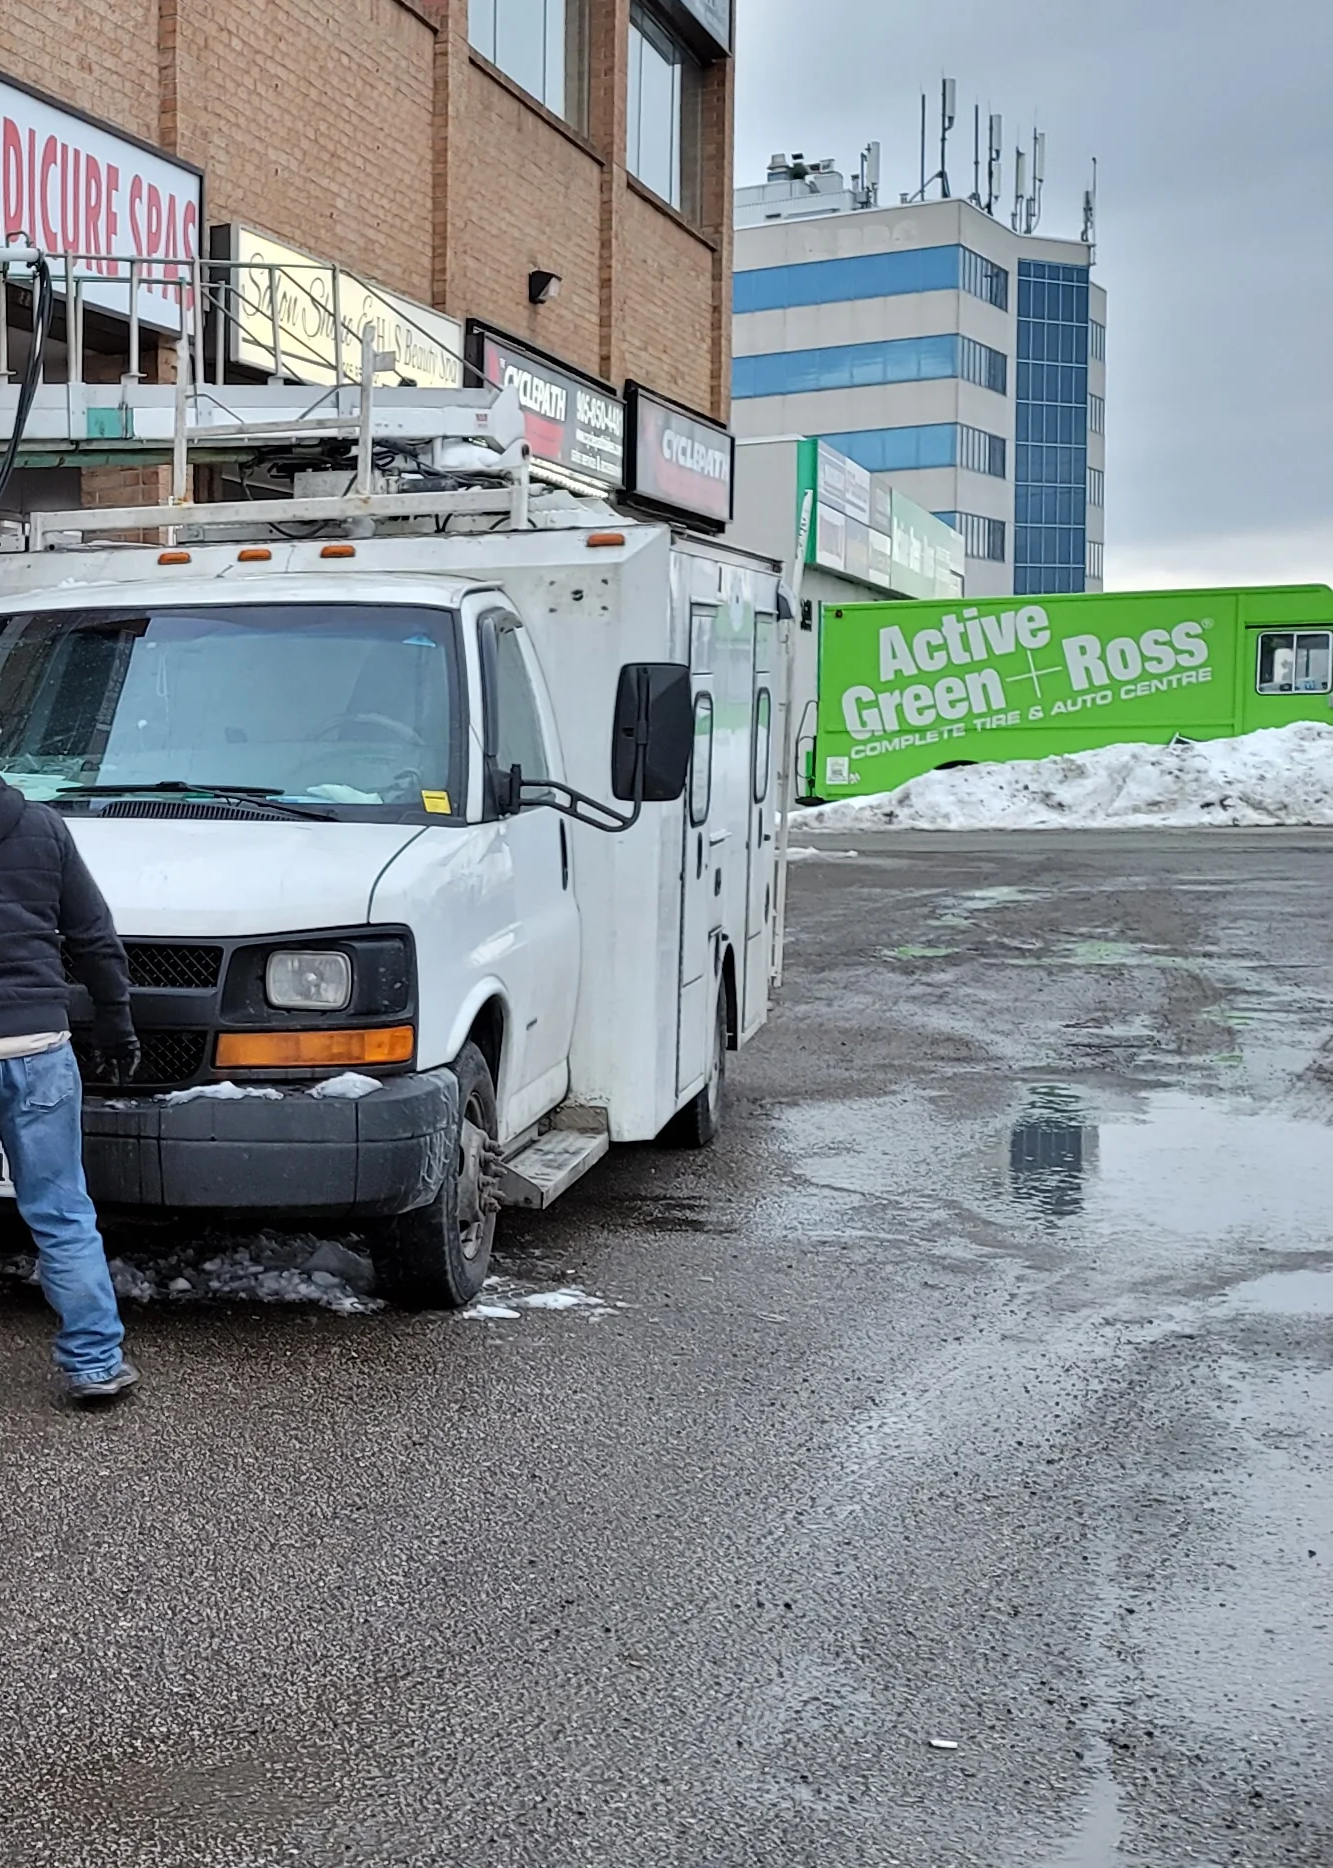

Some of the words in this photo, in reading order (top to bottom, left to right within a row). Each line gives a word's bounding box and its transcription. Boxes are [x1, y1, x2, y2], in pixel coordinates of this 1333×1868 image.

[129, 174, 196, 311] SPAS
[879, 605, 1051, 682] Active
[841, 667, 1007, 739] Green
[850, 723, 966, 760] COMPLETE
[974, 710, 1021, 733] TIRE
[1028, 705, 1044, 720] &
[1050, 689, 1113, 716] AUTO
[1120, 667, 1213, 701] CENTRE
